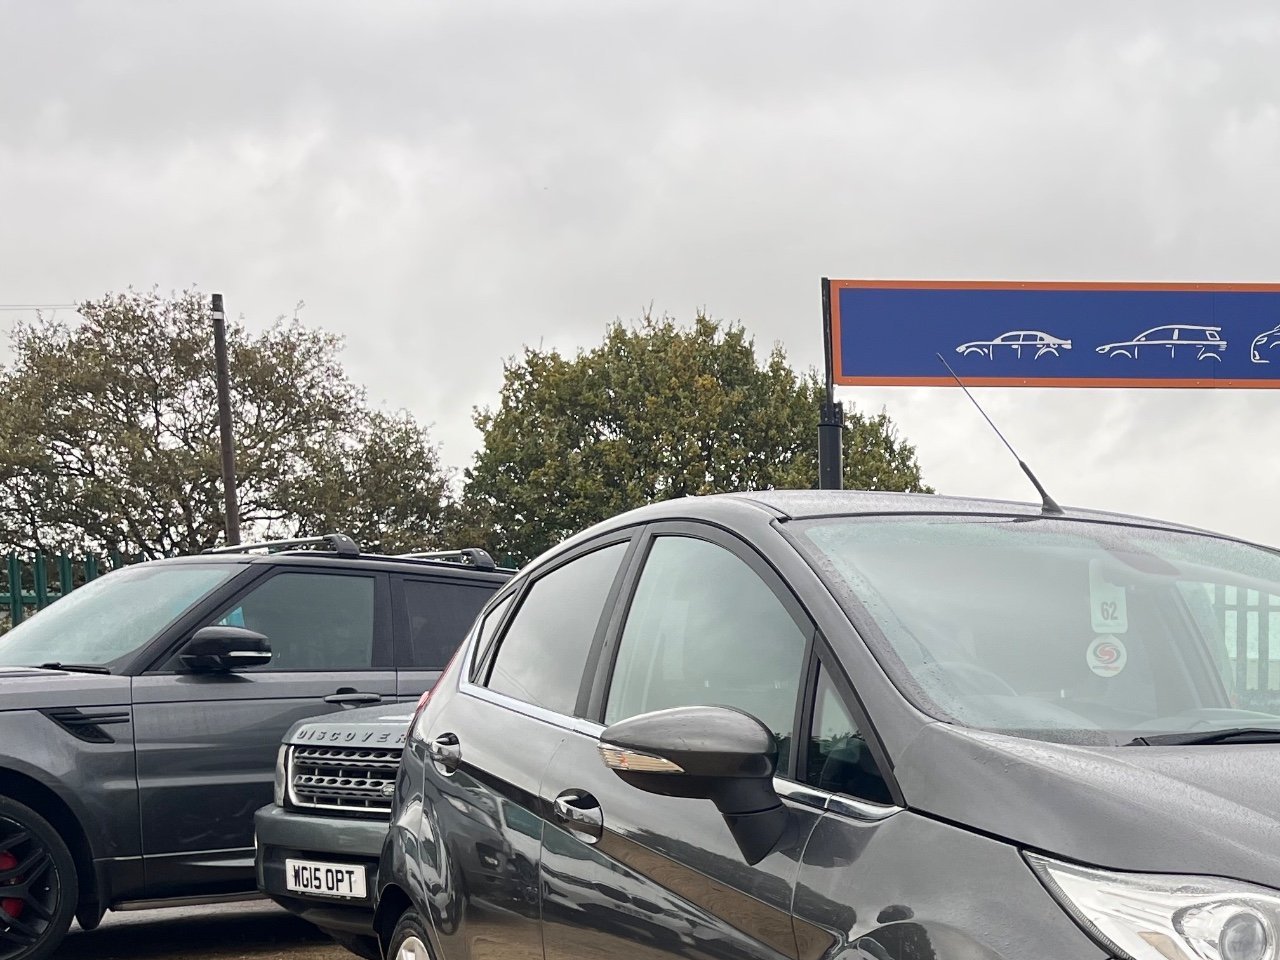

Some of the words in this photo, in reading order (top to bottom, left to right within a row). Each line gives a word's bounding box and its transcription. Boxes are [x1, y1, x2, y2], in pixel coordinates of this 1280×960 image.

[1101, 601, 1118, 621] 62
[293, 864, 321, 890] WG15
[325, 868, 354, 893] OPT
